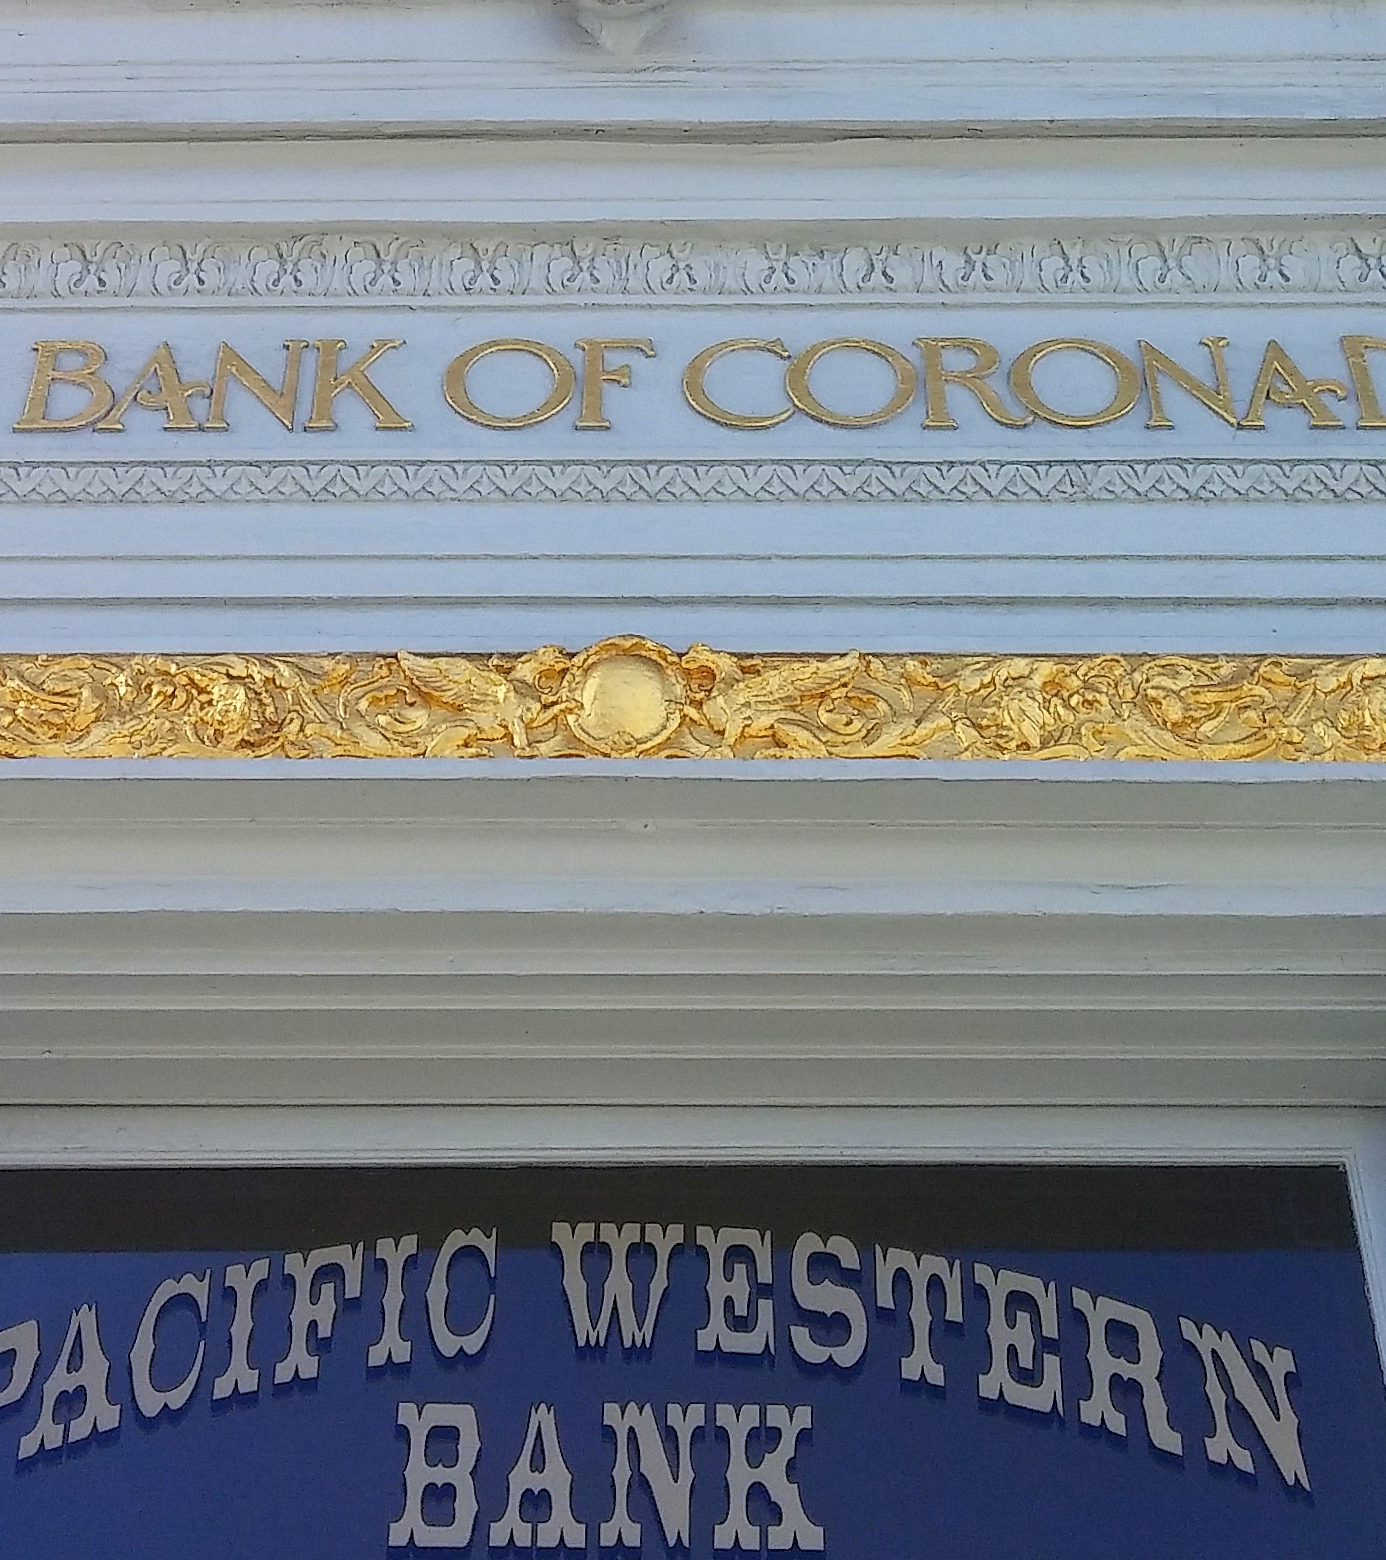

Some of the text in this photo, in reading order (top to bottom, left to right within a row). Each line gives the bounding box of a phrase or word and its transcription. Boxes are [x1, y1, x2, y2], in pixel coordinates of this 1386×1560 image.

[12, 338, 414, 433] BANK
[442, 336, 656, 432] OF
[549, 1220, 1313, 1493] WESTERN
[387, 1401, 826, 1551] BANK
